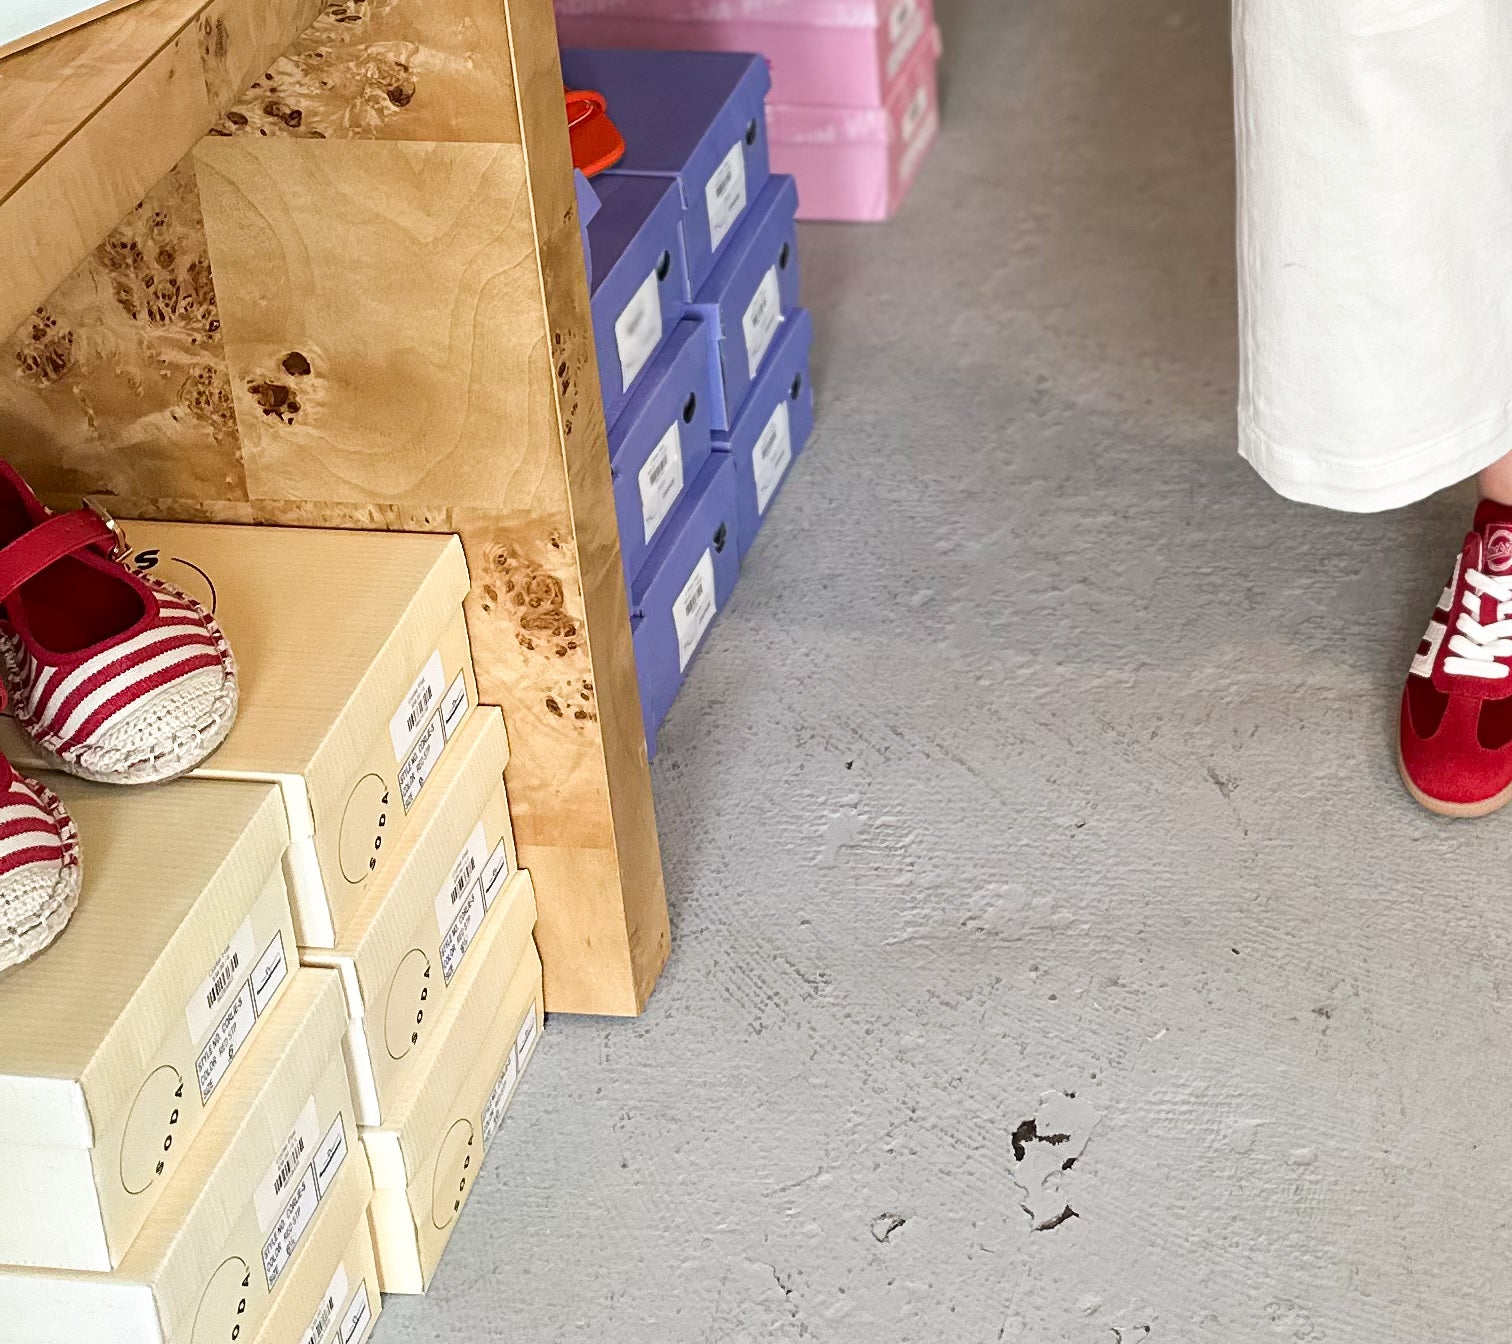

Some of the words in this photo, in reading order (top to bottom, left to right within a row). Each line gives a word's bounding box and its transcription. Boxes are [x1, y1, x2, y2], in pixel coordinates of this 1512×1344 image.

[369, 791, 389, 871] SODA
[411, 965, 431, 1045] SODA
[155, 1082, 184, 1176] SODA
[454, 1134, 474, 1212] SODA
[231, 1271, 251, 1342] ODA
